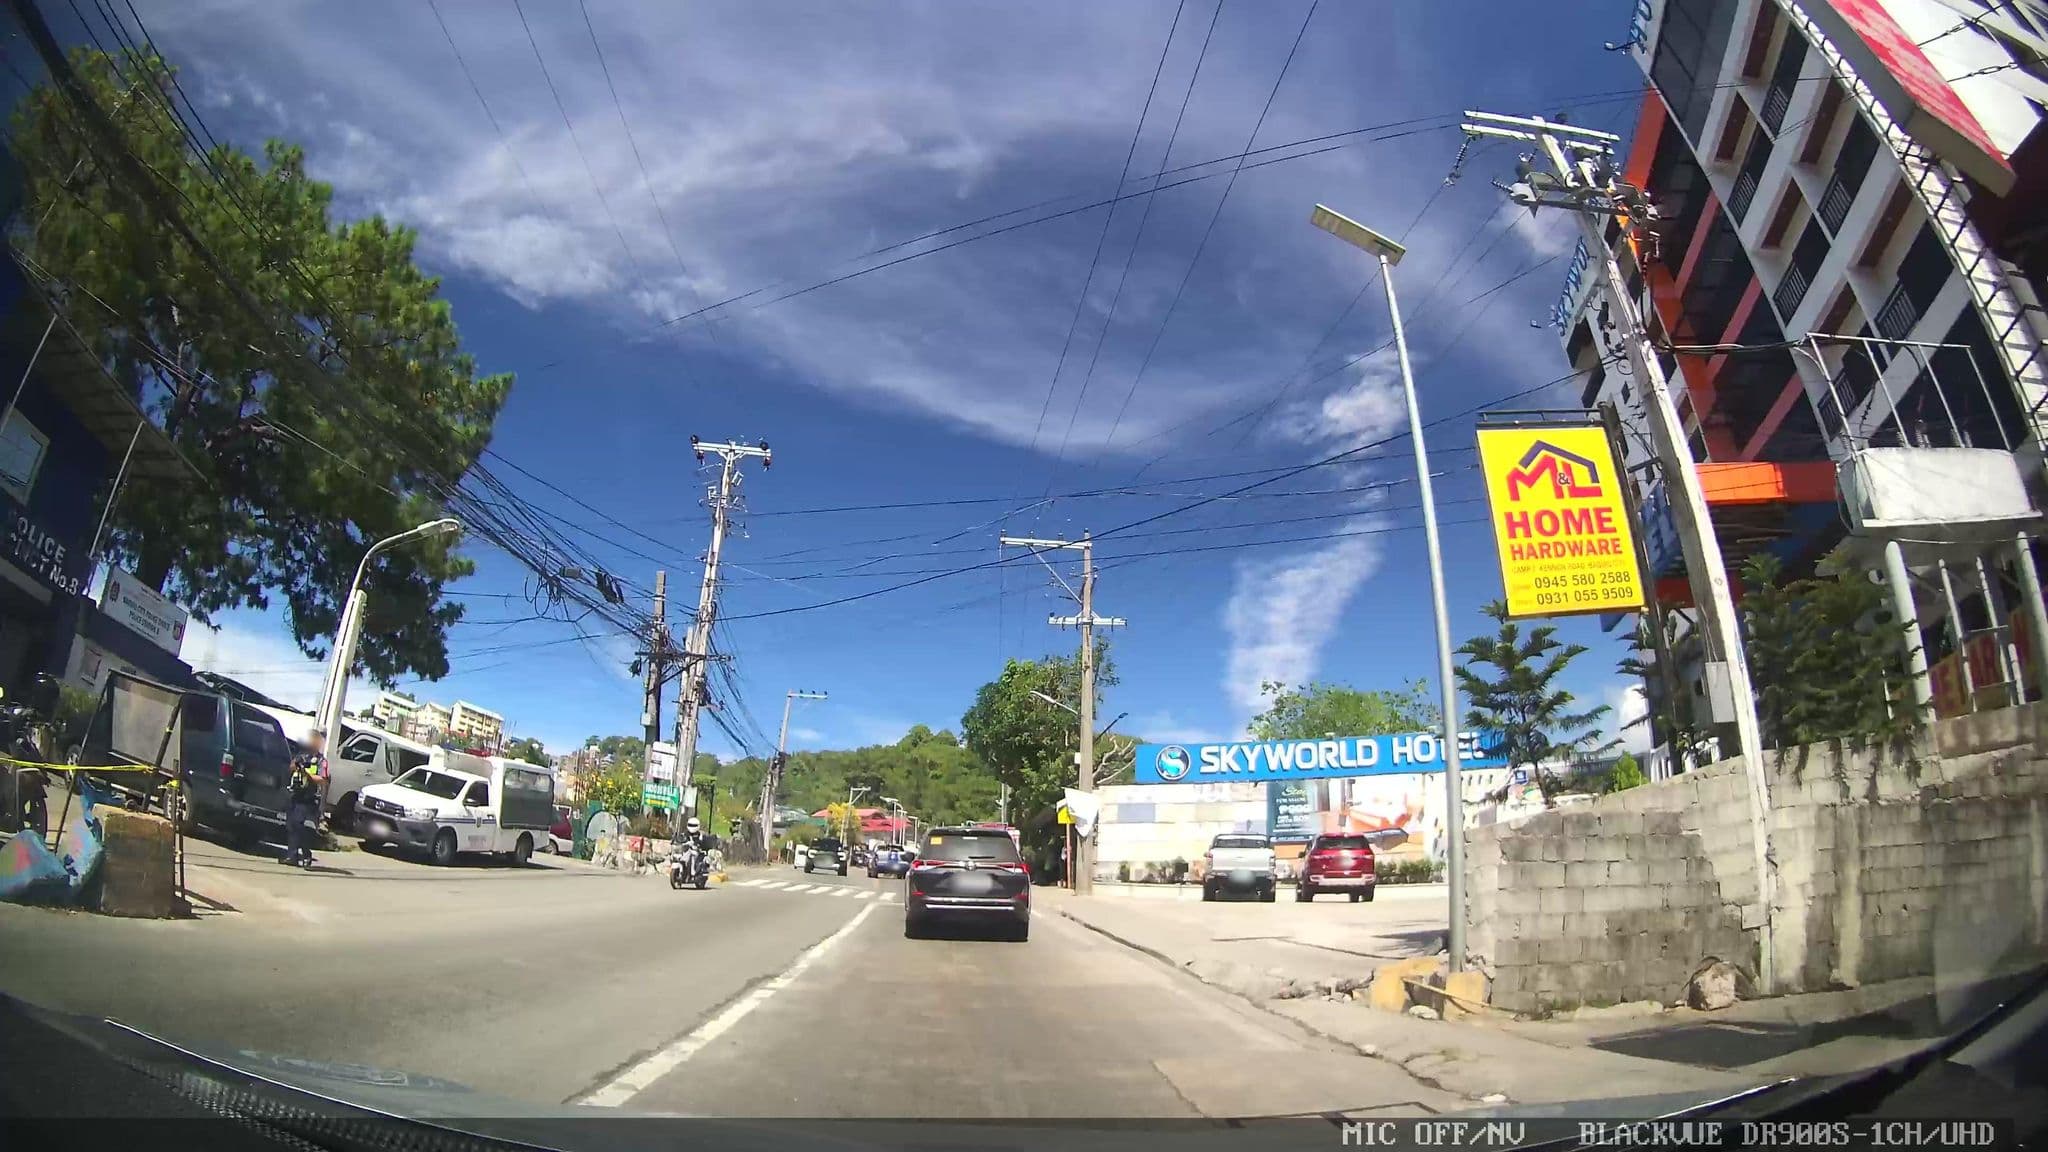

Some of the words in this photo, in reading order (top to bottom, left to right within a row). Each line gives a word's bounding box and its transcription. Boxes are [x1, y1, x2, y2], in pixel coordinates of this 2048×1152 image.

[1504, 507, 1618, 539] HOME
[14, 513, 67, 564] OLICE
[1510, 538, 1624, 562] HARDWARE
[1534, 575, 1567, 589] 0945
[1572, 573, 1595, 586] 580
[1600, 571, 1631, 584] 2588
[1536, 591, 1568, 605] 0931
[1574, 589, 1598, 602] 055
[1602, 586, 1633, 600] 9509
[1199, 738, 1378, 774] SKYWORLD
